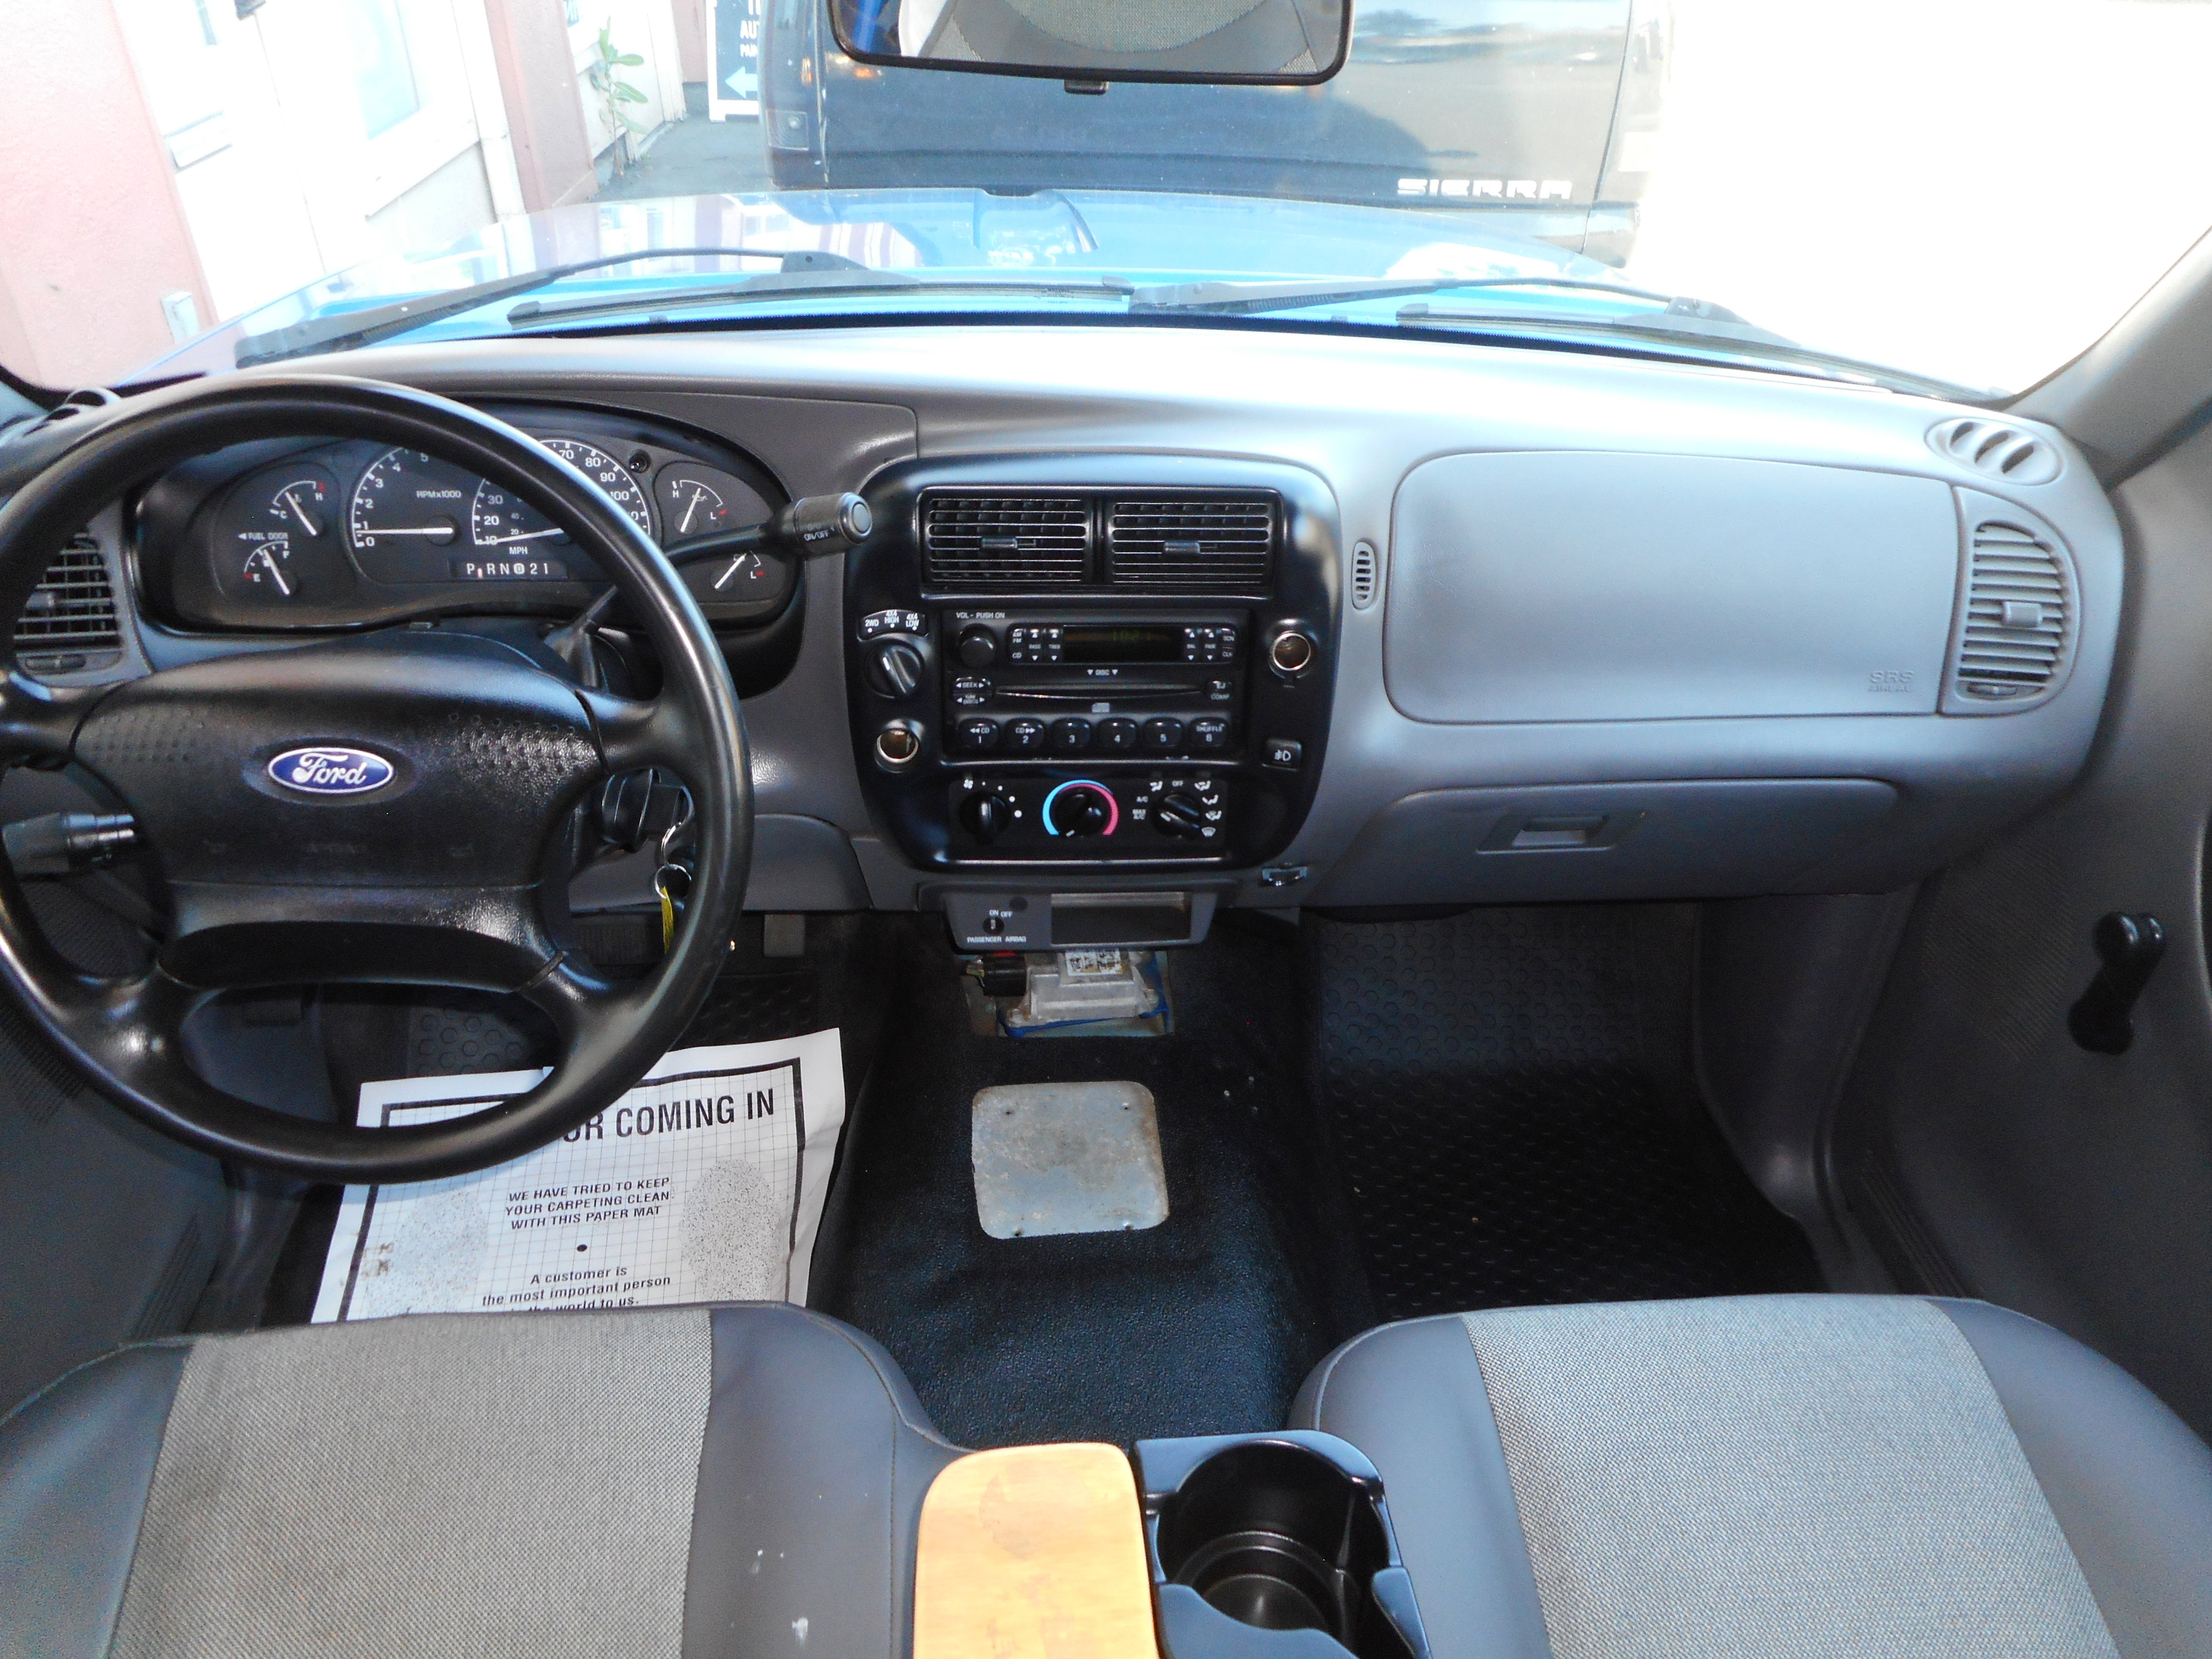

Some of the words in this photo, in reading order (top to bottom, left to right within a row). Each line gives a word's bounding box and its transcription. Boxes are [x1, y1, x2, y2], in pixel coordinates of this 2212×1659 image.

[1398, 179, 1573, 199] SIERRA
[392, 462, 401, 471] 4
[585, 457, 601, 467] 80
[600, 472, 616, 482] 90
[375, 478, 384, 489] 3
[487, 495, 504, 504] 30
[610, 491, 629, 501] 100
[365, 498, 374, 508] 2
[710, 511, 717, 520] L
[483, 516, 500, 526] 20
[365, 536, 375, 547] 0
[509, 547, 529, 555] MPH
[466, 562, 475, 575] P
[486, 562, 496, 575] R
[500, 562, 510, 575] N
[529, 562, 538, 575] 2
[543, 562, 549, 575] 1
[750, 571, 757, 579] L
[865, 619, 880, 627] 2WD
[884, 616, 900, 624] HIGH
[905, 619, 920, 628] LOW
[1869, 670, 1914, 684] SRS
[1023, 735, 1030, 744] 2
[1069, 735, 1076, 743] 3
[1114, 734, 1121, 742] 4
[291, 751, 368, 790] Ford
[616, 1095, 735, 1138] COMING
[747, 1088, 775, 1120] IN
[509, 1191, 529, 1202] WE
[533, 1186, 568, 1200] HAVE
[573, 1183, 611, 1195] TRIED
[617, 1181, 632, 1191] TO
[637, 1177, 669, 1189] KEEP
[506, 1204, 542, 1217] YOUR
[547, 1195, 622, 1212] CARPETING
[511, 1218, 546, 1230] WITH
[551, 1213, 581, 1226] THIS
[586, 1209, 629, 1223] PAPER
[633, 1205, 662, 1217] MAT
[530, 1274, 540, 1285] A
[545, 1268, 612, 1283] customer
[616, 1266, 628, 1277] is
[482, 1294, 504, 1307] the
[510, 1289, 545, 1303] most
[550, 1282, 619, 1300] important
[623, 1275, 672, 1293] person
[556, 1299, 596, 1311] world
[600, 1297, 613, 1308] to
[618, 1296, 638, 1306] us.
